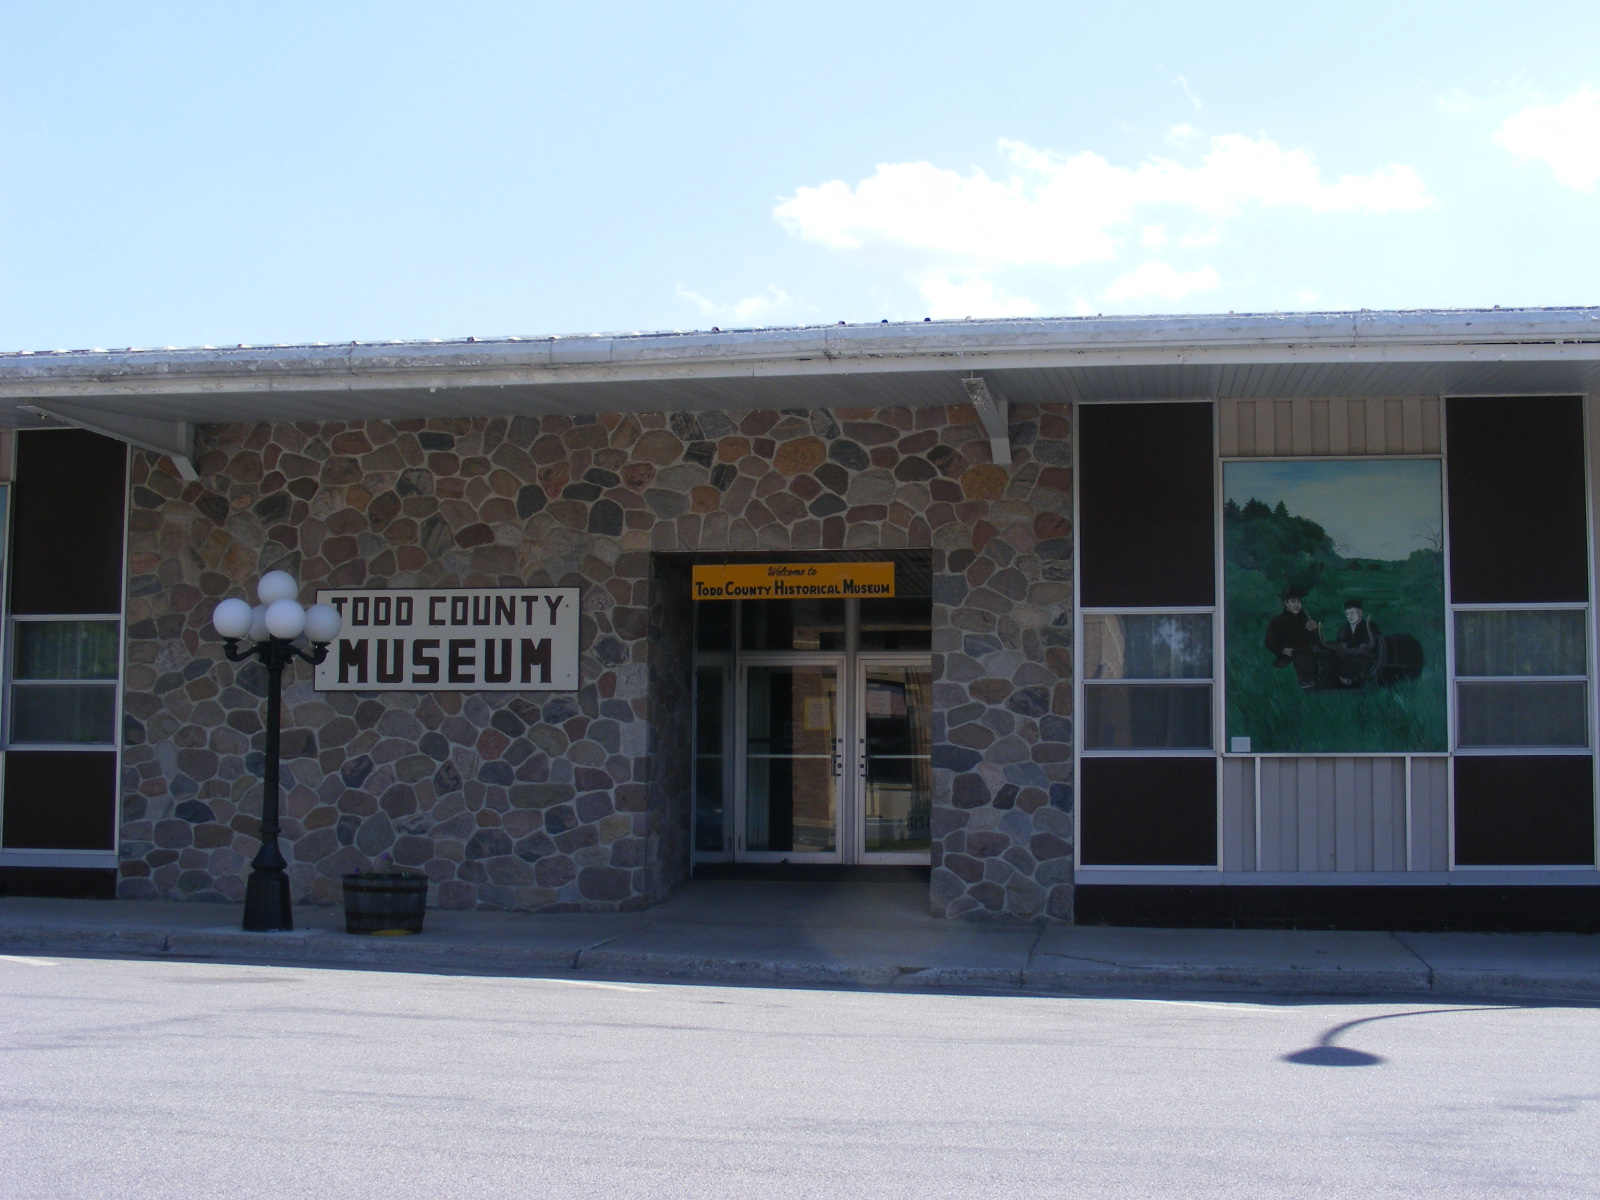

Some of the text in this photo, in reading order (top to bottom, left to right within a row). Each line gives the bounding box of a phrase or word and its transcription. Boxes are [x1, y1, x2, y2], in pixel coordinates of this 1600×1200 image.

[767, 566, 818, 576] Welcome to
[695, 579, 890, 596] TODD COUNTY HISTORICAL MUSEUM
[331, 595, 564, 626] TODD COUNTY
[337, 638, 552, 684] MUSEUM
